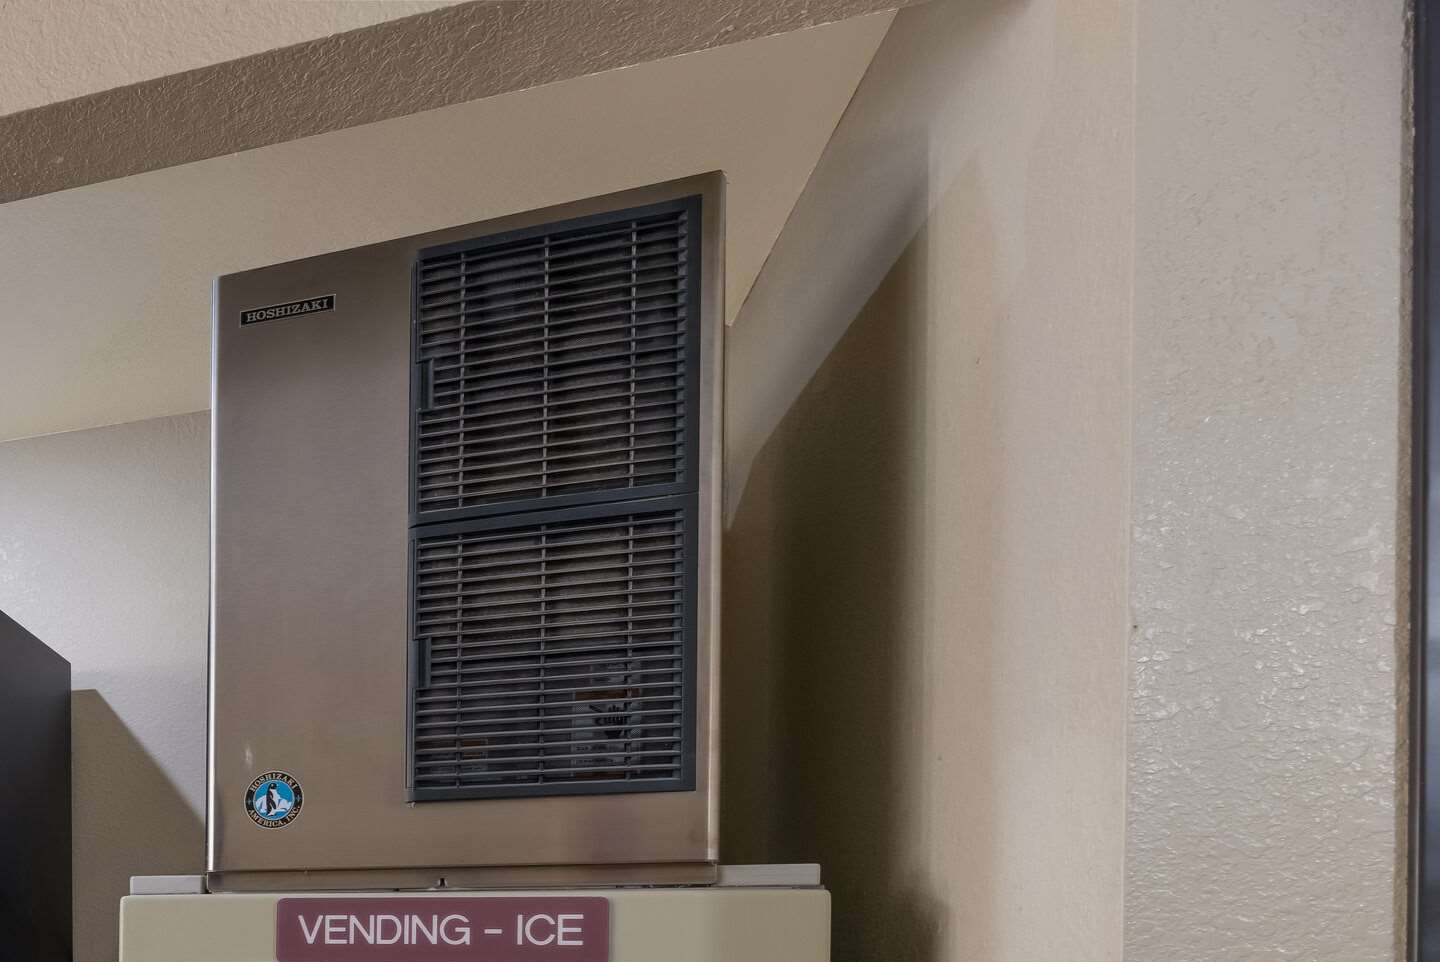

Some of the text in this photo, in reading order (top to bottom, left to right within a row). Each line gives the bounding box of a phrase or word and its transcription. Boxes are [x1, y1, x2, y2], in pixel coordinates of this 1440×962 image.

[246, 299, 329, 322] HOSHIZAKI
[249, 773, 299, 792] HOSHIZAKI
[297, 914, 471, 946] VENDING
[515, 914, 585, 946] ICE
